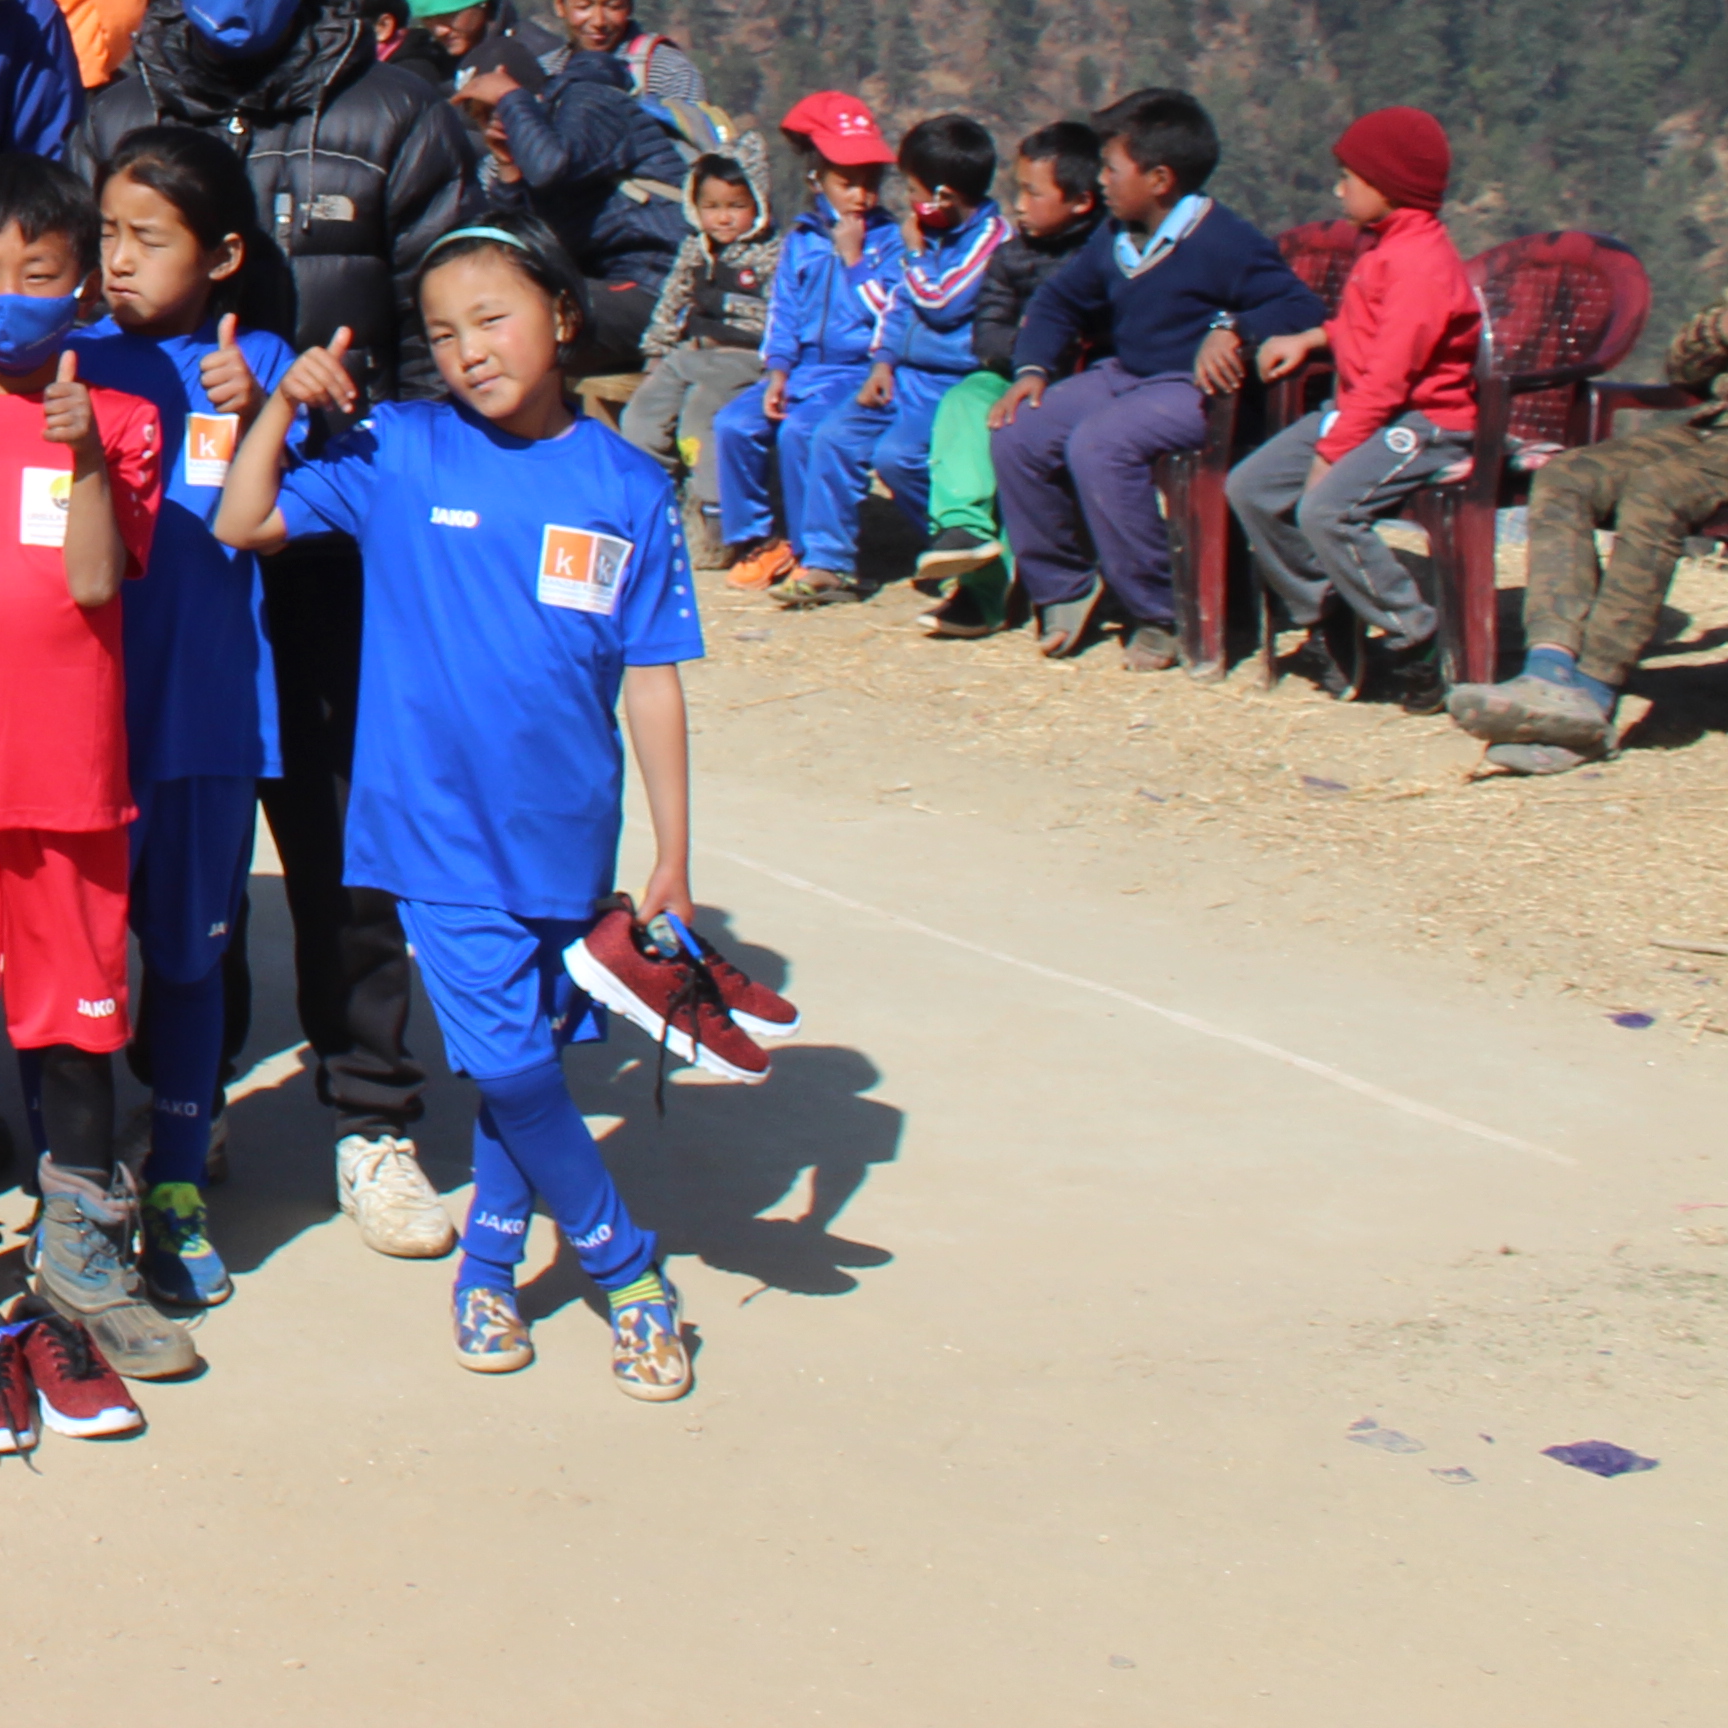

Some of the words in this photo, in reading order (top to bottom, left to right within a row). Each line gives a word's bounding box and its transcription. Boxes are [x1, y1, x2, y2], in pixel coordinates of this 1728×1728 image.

[430, 506, 480, 528] JAKO
[77, 998, 116, 1018] JAKO
[475, 1210, 526, 1235] JAKO
